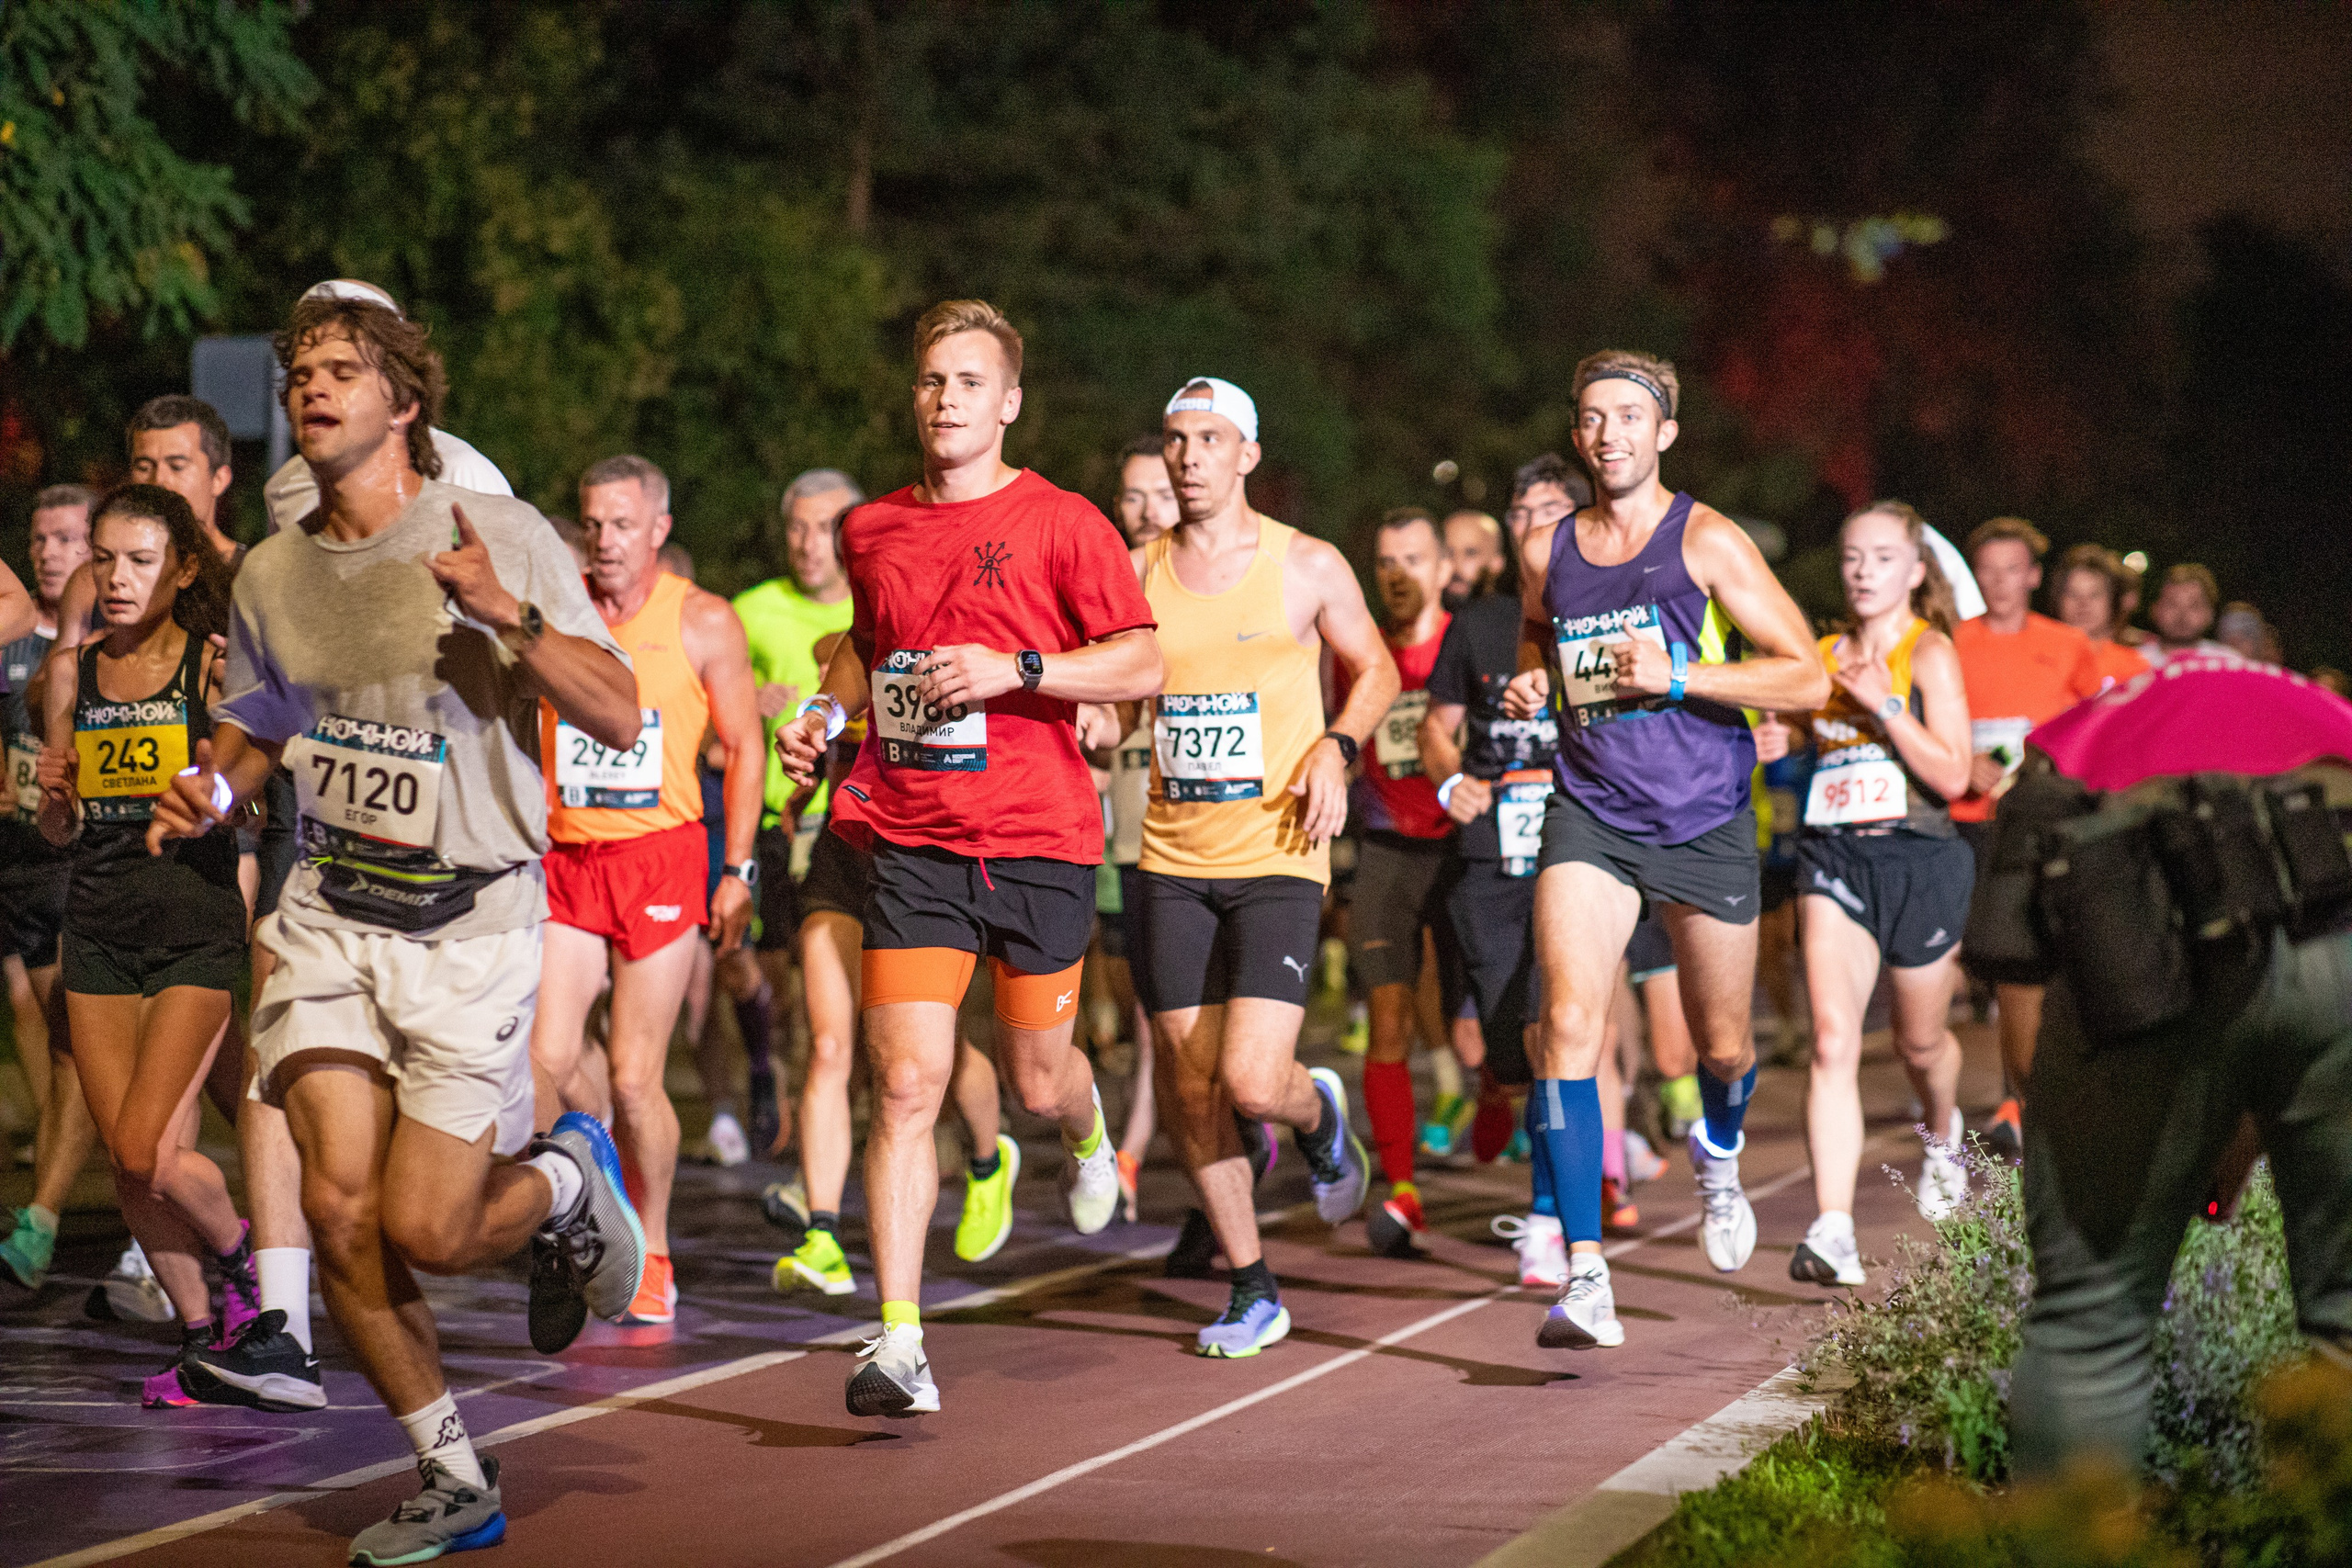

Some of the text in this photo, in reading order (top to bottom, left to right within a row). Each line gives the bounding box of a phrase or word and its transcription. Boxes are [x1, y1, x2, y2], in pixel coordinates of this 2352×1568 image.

[1575, 646, 1618, 682] 44
[900, 722, 955, 737] ВЛАДИМИР
[1167, 726, 1246, 758] 7372
[98, 738, 159, 775] 243
[571, 738, 647, 767] 2929
[1187, 761, 1222, 773] ПАВЕЛ
[102, 776, 157, 789] СВЕТЛАНА
[311, 754, 419, 816] 7120
[1825, 778, 1889, 812] 9512
[345, 808, 378, 826] ЕГОР
[368, 884, 439, 907] DEMIX
